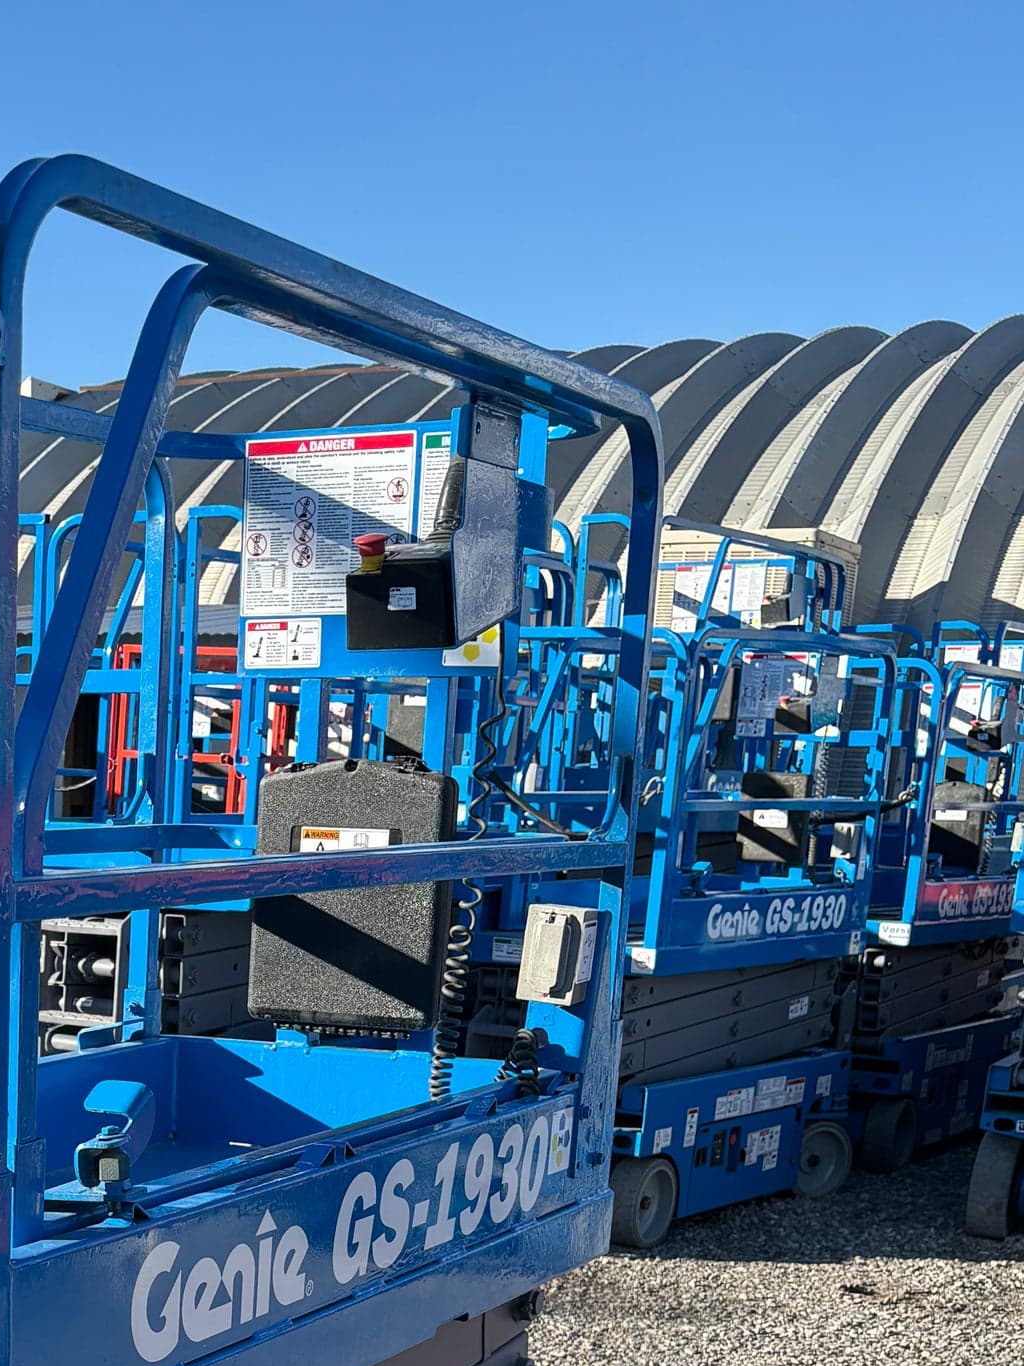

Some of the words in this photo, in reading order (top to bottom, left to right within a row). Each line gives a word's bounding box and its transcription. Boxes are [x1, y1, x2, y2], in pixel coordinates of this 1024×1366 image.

[309, 438, 355, 452] DANGER
[310, 831, 340, 840] WARNING
[707, 902, 760, 939] Genie
[765, 894, 846, 934] GS-1930
[938, 888, 969, 917] Genie
[972, 884, 1013, 914] GS-193
[131, 1209, 311, 1363] Genie
[332, 1116, 549, 1284] GS-1930
